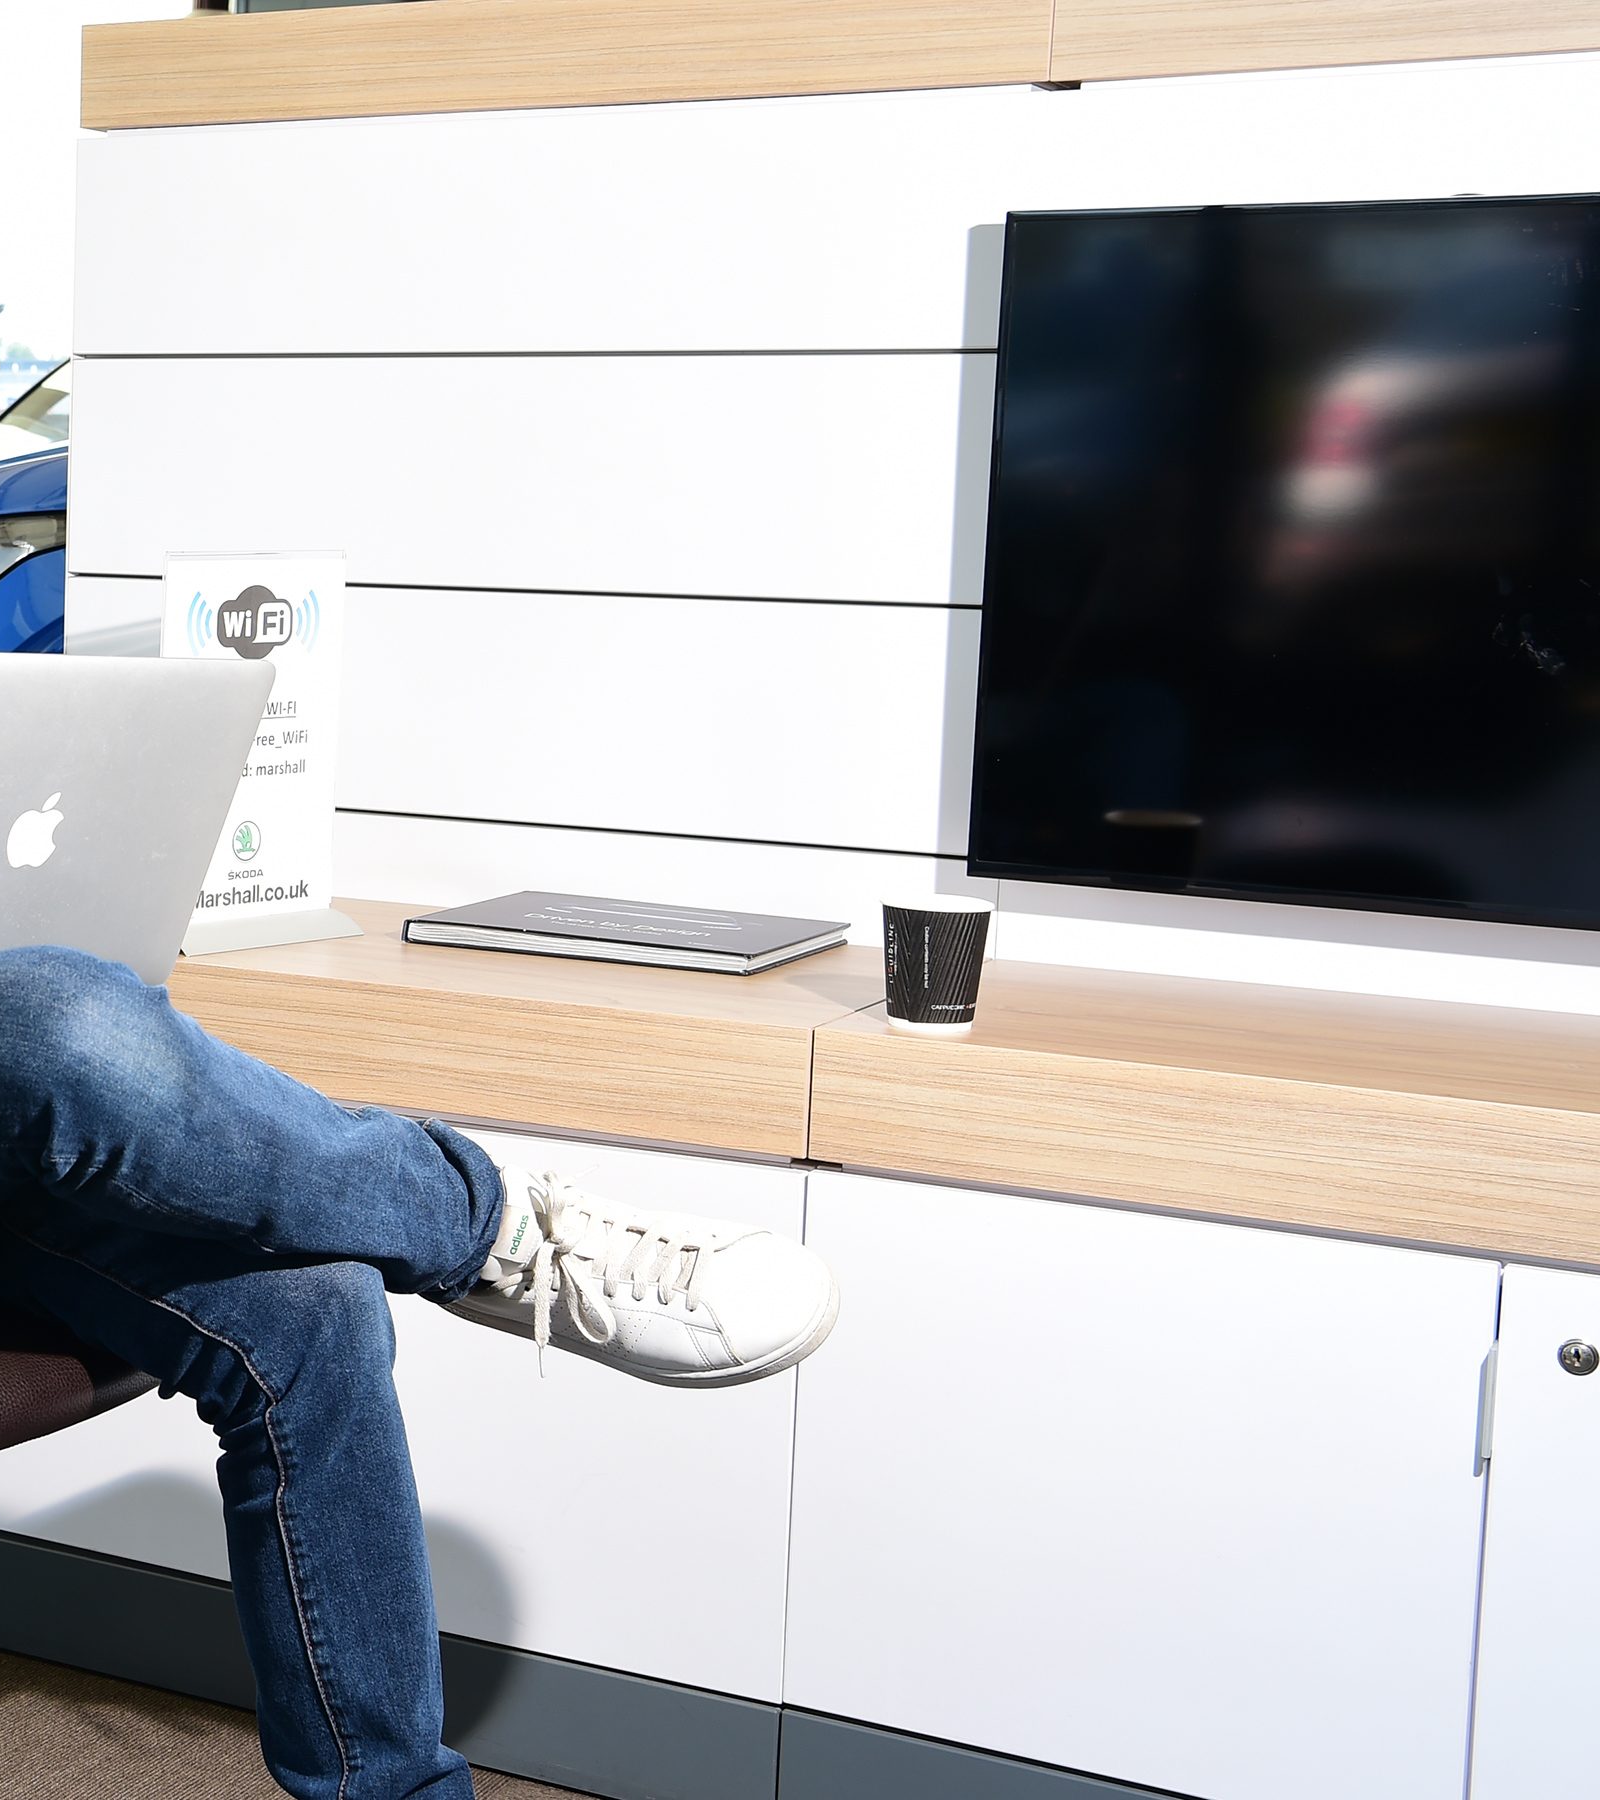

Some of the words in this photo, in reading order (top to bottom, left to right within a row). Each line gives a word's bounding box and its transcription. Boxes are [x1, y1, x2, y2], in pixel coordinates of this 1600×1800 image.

[266, 701, 297, 715] WI-FI
[256, 758, 305, 776] marshall
[227, 869, 264, 880] ŠKODA
[524, 911, 595, 925] Driven
[600, 921, 630, 929] by
[633, 924, 711, 937] Design
[509, 1214, 529, 1256] adidas
